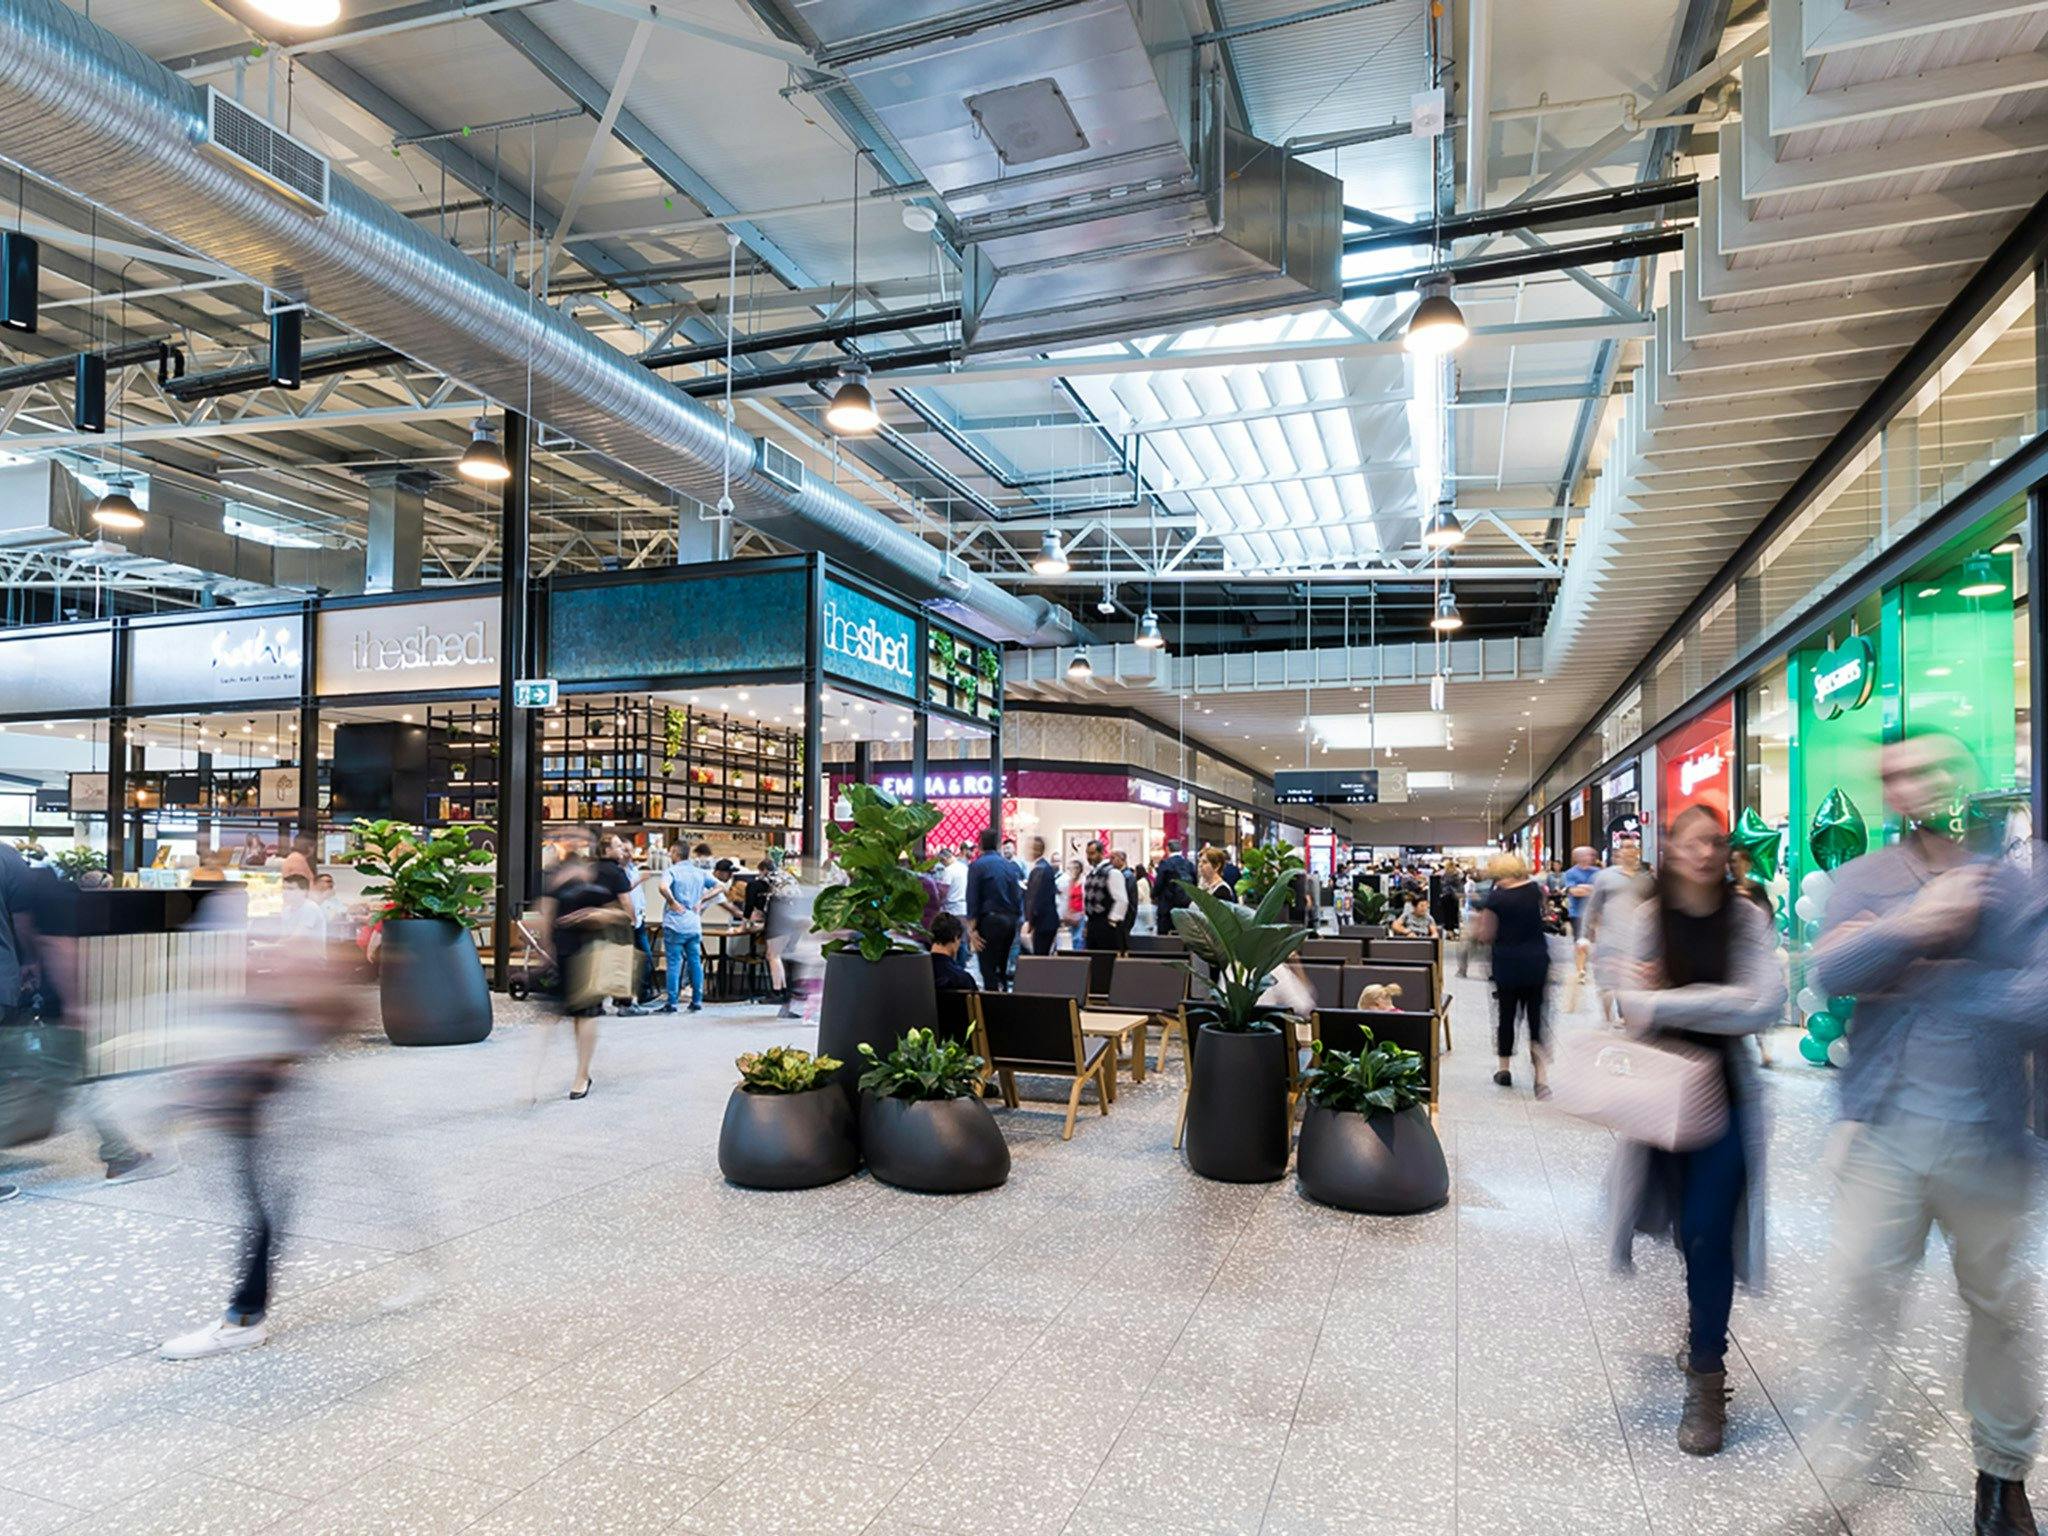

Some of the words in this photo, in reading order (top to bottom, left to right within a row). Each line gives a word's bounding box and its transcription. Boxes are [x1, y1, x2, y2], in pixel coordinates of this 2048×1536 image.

[353, 620, 495, 672] theshed.
[823, 600, 913, 678] theshed.
[882, 777, 946, 796] EMA
